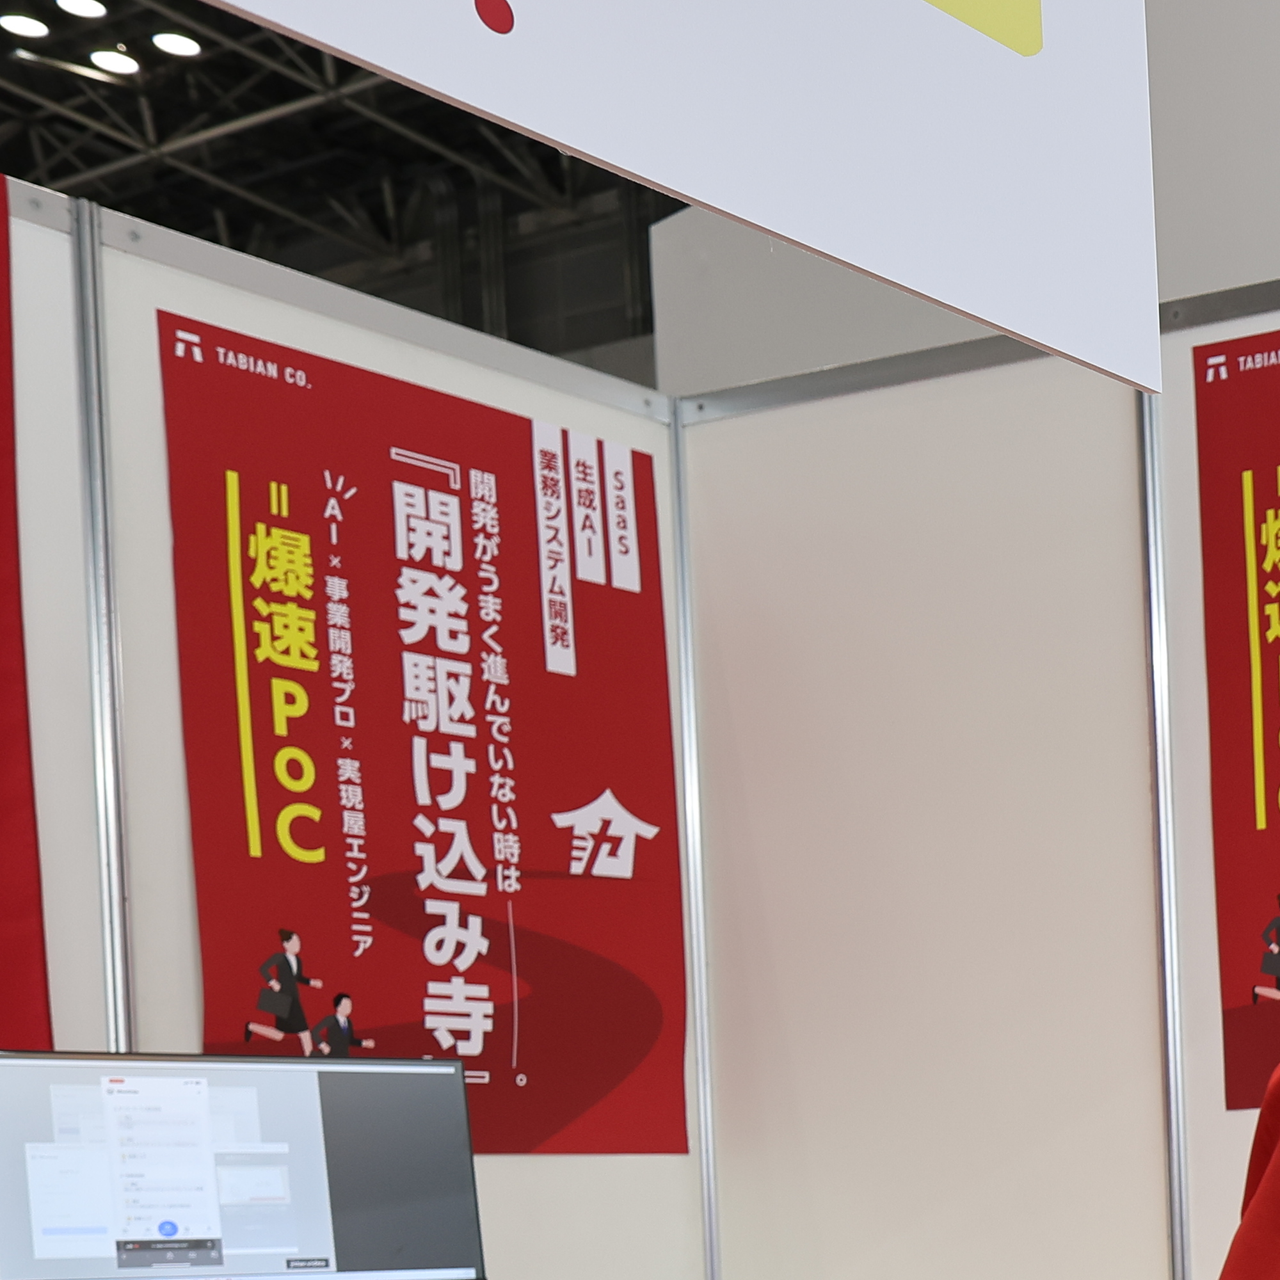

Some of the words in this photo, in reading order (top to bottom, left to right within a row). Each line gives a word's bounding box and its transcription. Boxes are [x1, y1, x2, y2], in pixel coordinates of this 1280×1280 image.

[214, 344, 279, 382] TABIAN
[282, 365, 314, 392] CO.
[539, 447, 571, 652] 業務システム開発
[573, 458, 597, 560] 生成AI
[611, 469, 632, 557] SaaS
[469, 469, 522, 894] 開発がうまく進んでいない時は
